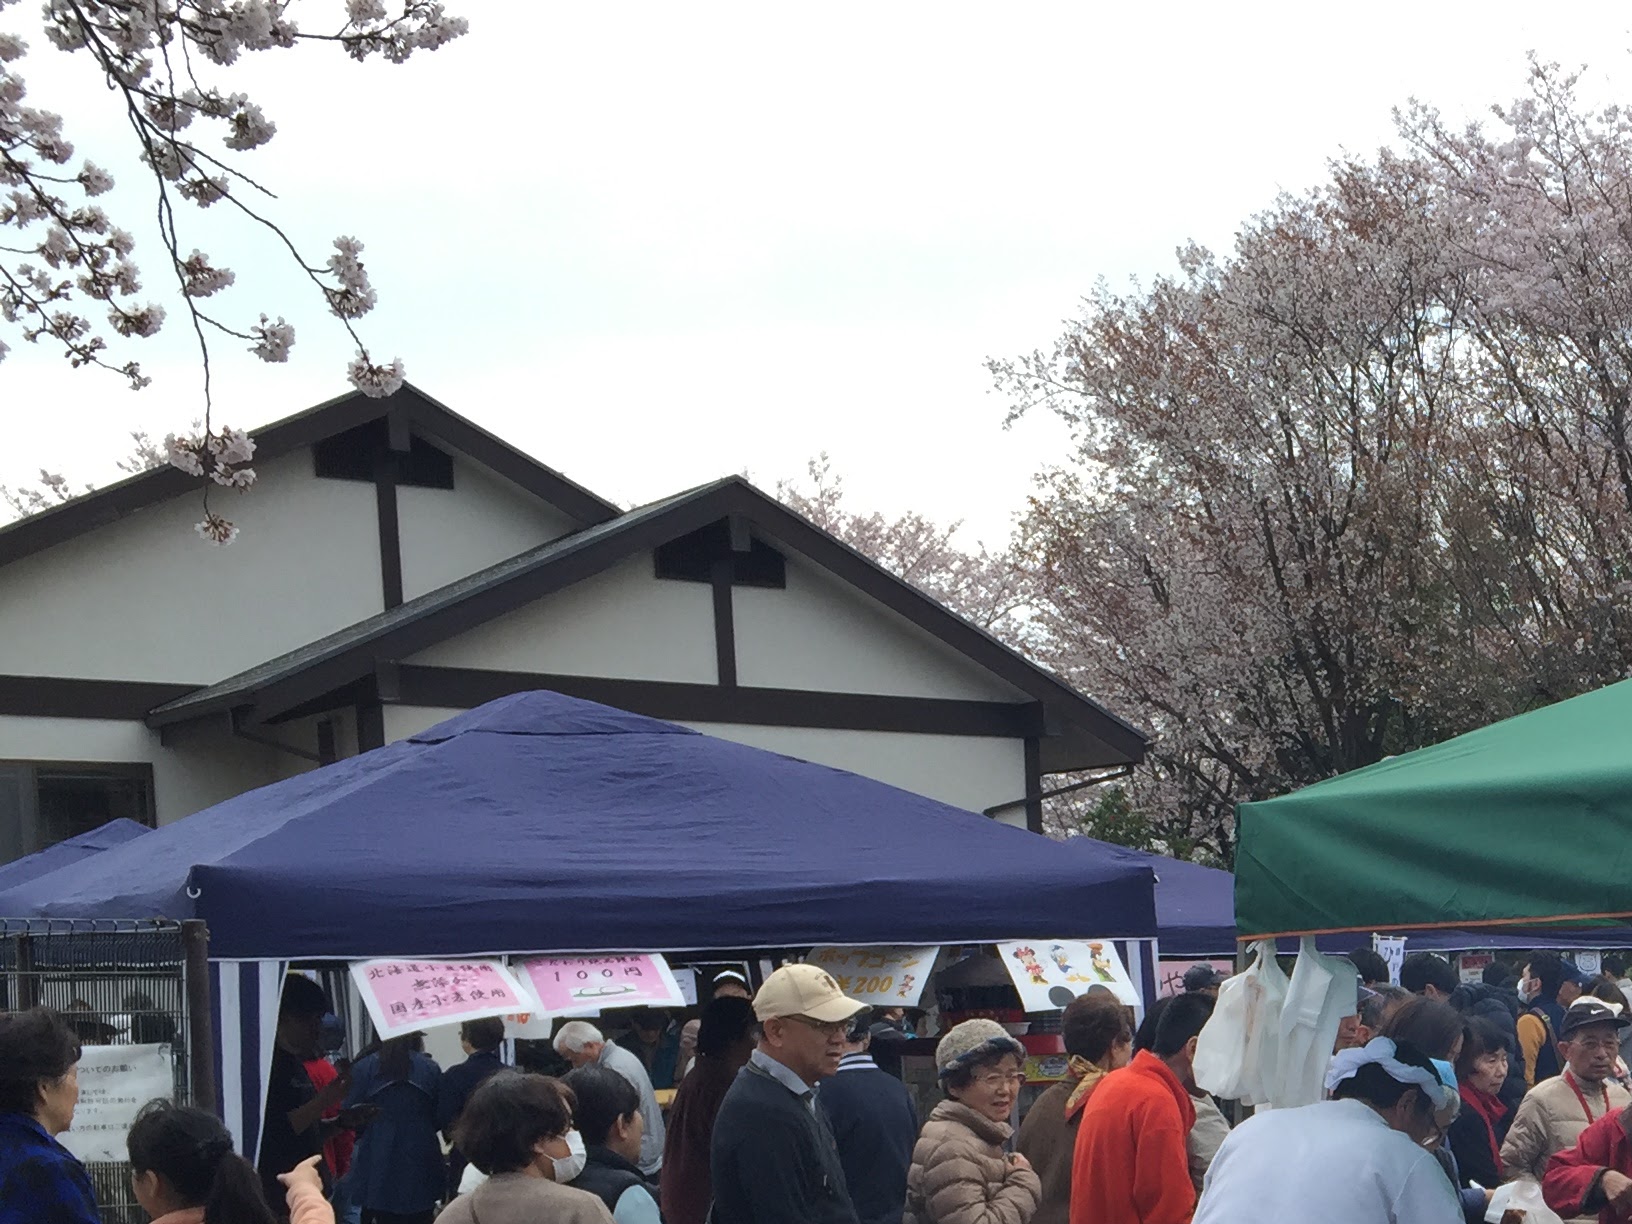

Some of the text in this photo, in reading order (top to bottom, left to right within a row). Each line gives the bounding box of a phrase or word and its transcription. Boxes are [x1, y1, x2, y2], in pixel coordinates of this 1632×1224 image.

[389, 988, 506, 1016] 国産小麦使用
